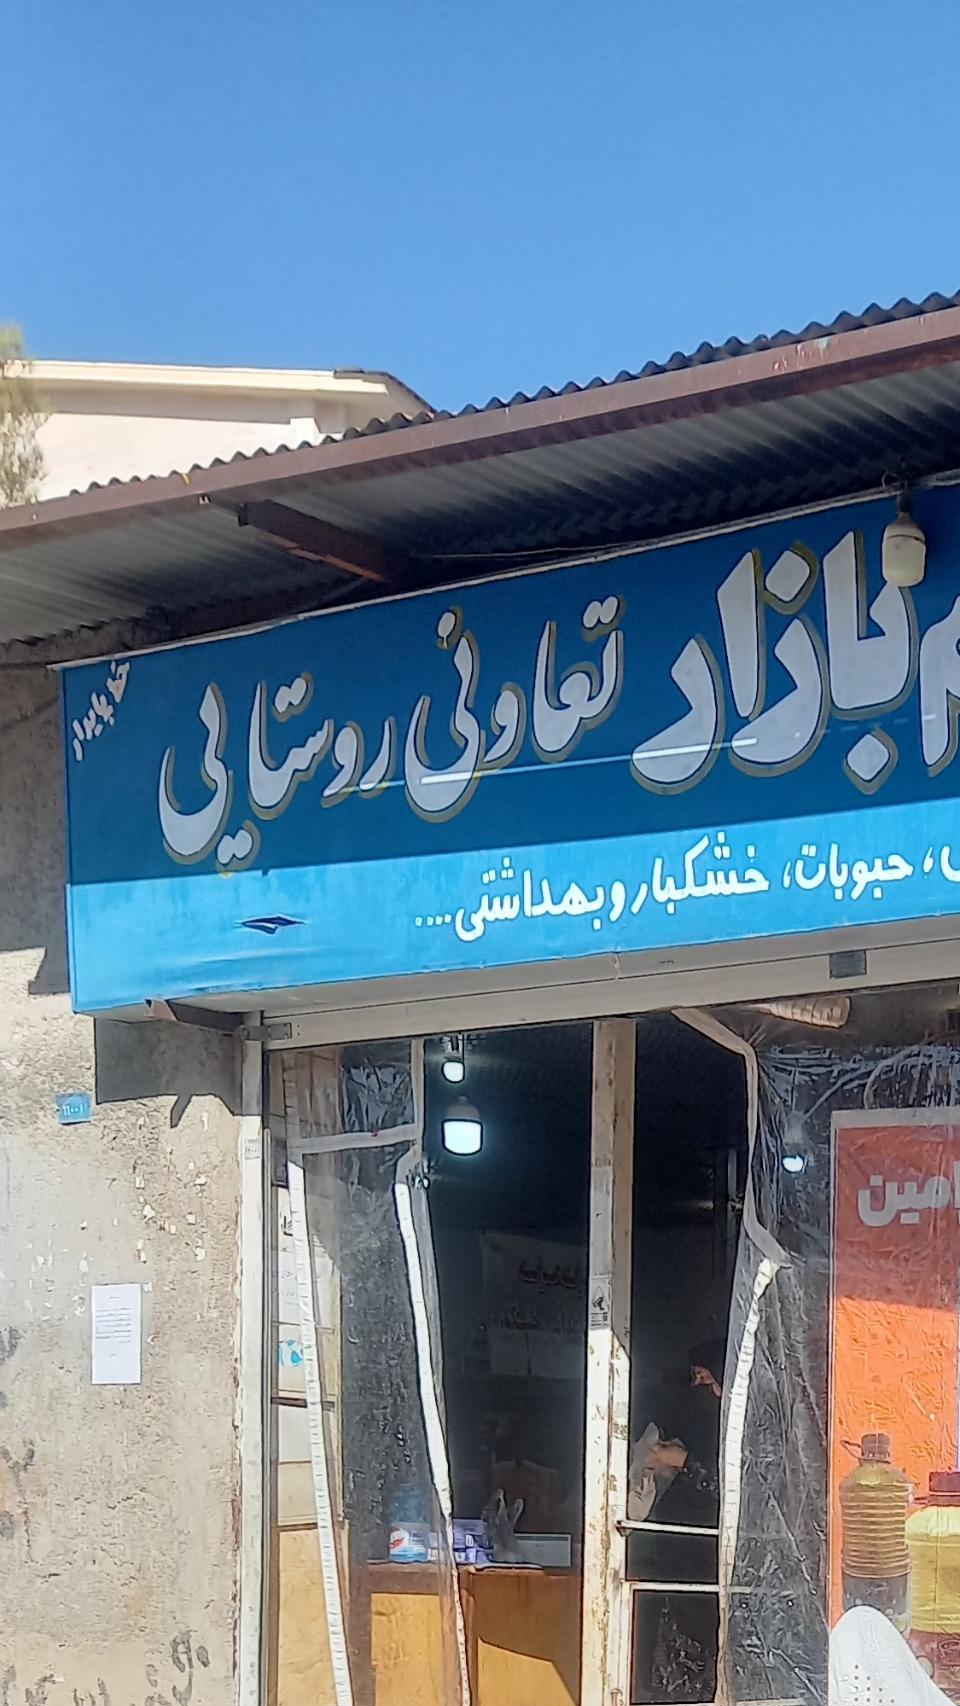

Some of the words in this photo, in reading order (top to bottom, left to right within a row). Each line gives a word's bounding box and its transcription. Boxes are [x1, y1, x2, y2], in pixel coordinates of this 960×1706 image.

[403, 595, 622, 814] تعاونی
[631, 530, 915, 786] بازار
[157, 676, 393, 865] روستایی
[631, 831, 770, 915] خشکبار
